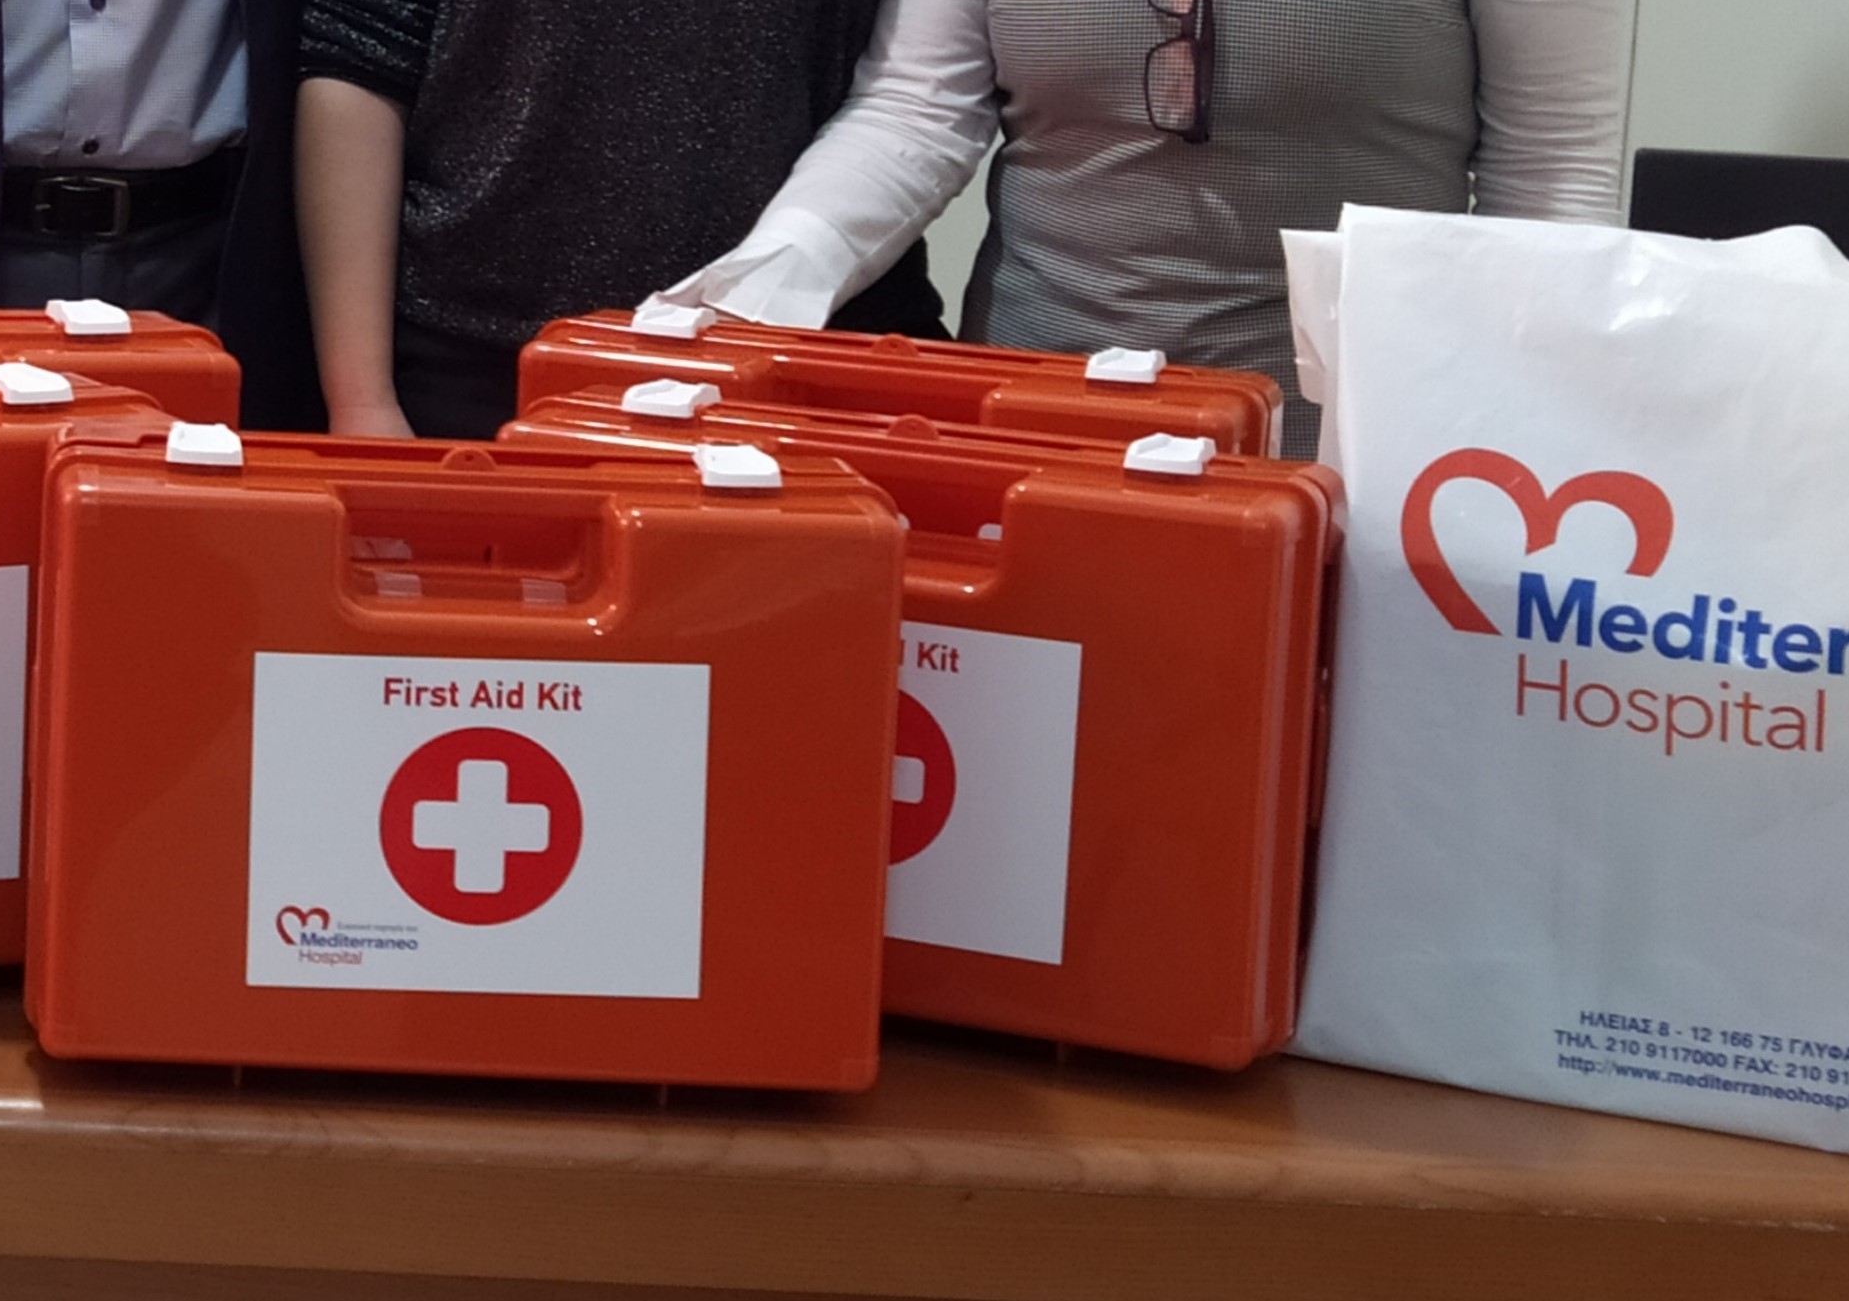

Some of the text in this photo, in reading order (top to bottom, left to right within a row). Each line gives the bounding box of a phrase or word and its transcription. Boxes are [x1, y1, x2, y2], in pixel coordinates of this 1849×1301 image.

[1516, 572, 1849, 676] Mediter
[917, 641, 959, 674] Kit
[383, 677, 582, 712] First Aid Kit
[1516, 653, 1826, 756] Hospital
[299, 932, 419, 950] Mediterraneo
[299, 950, 363, 967] Hospital
[1658, 1021, 1670, 1038] 8
[1690, 1027, 1712, 1043] 12
[1720, 1031, 1752, 1049] 166
[1760, 1035, 1783, 1053] 75
[1605, 1037, 1640, 1055] 210
[1646, 1043, 1728, 1068] 9117000
[1786, 1063, 1821, 1082] 210
